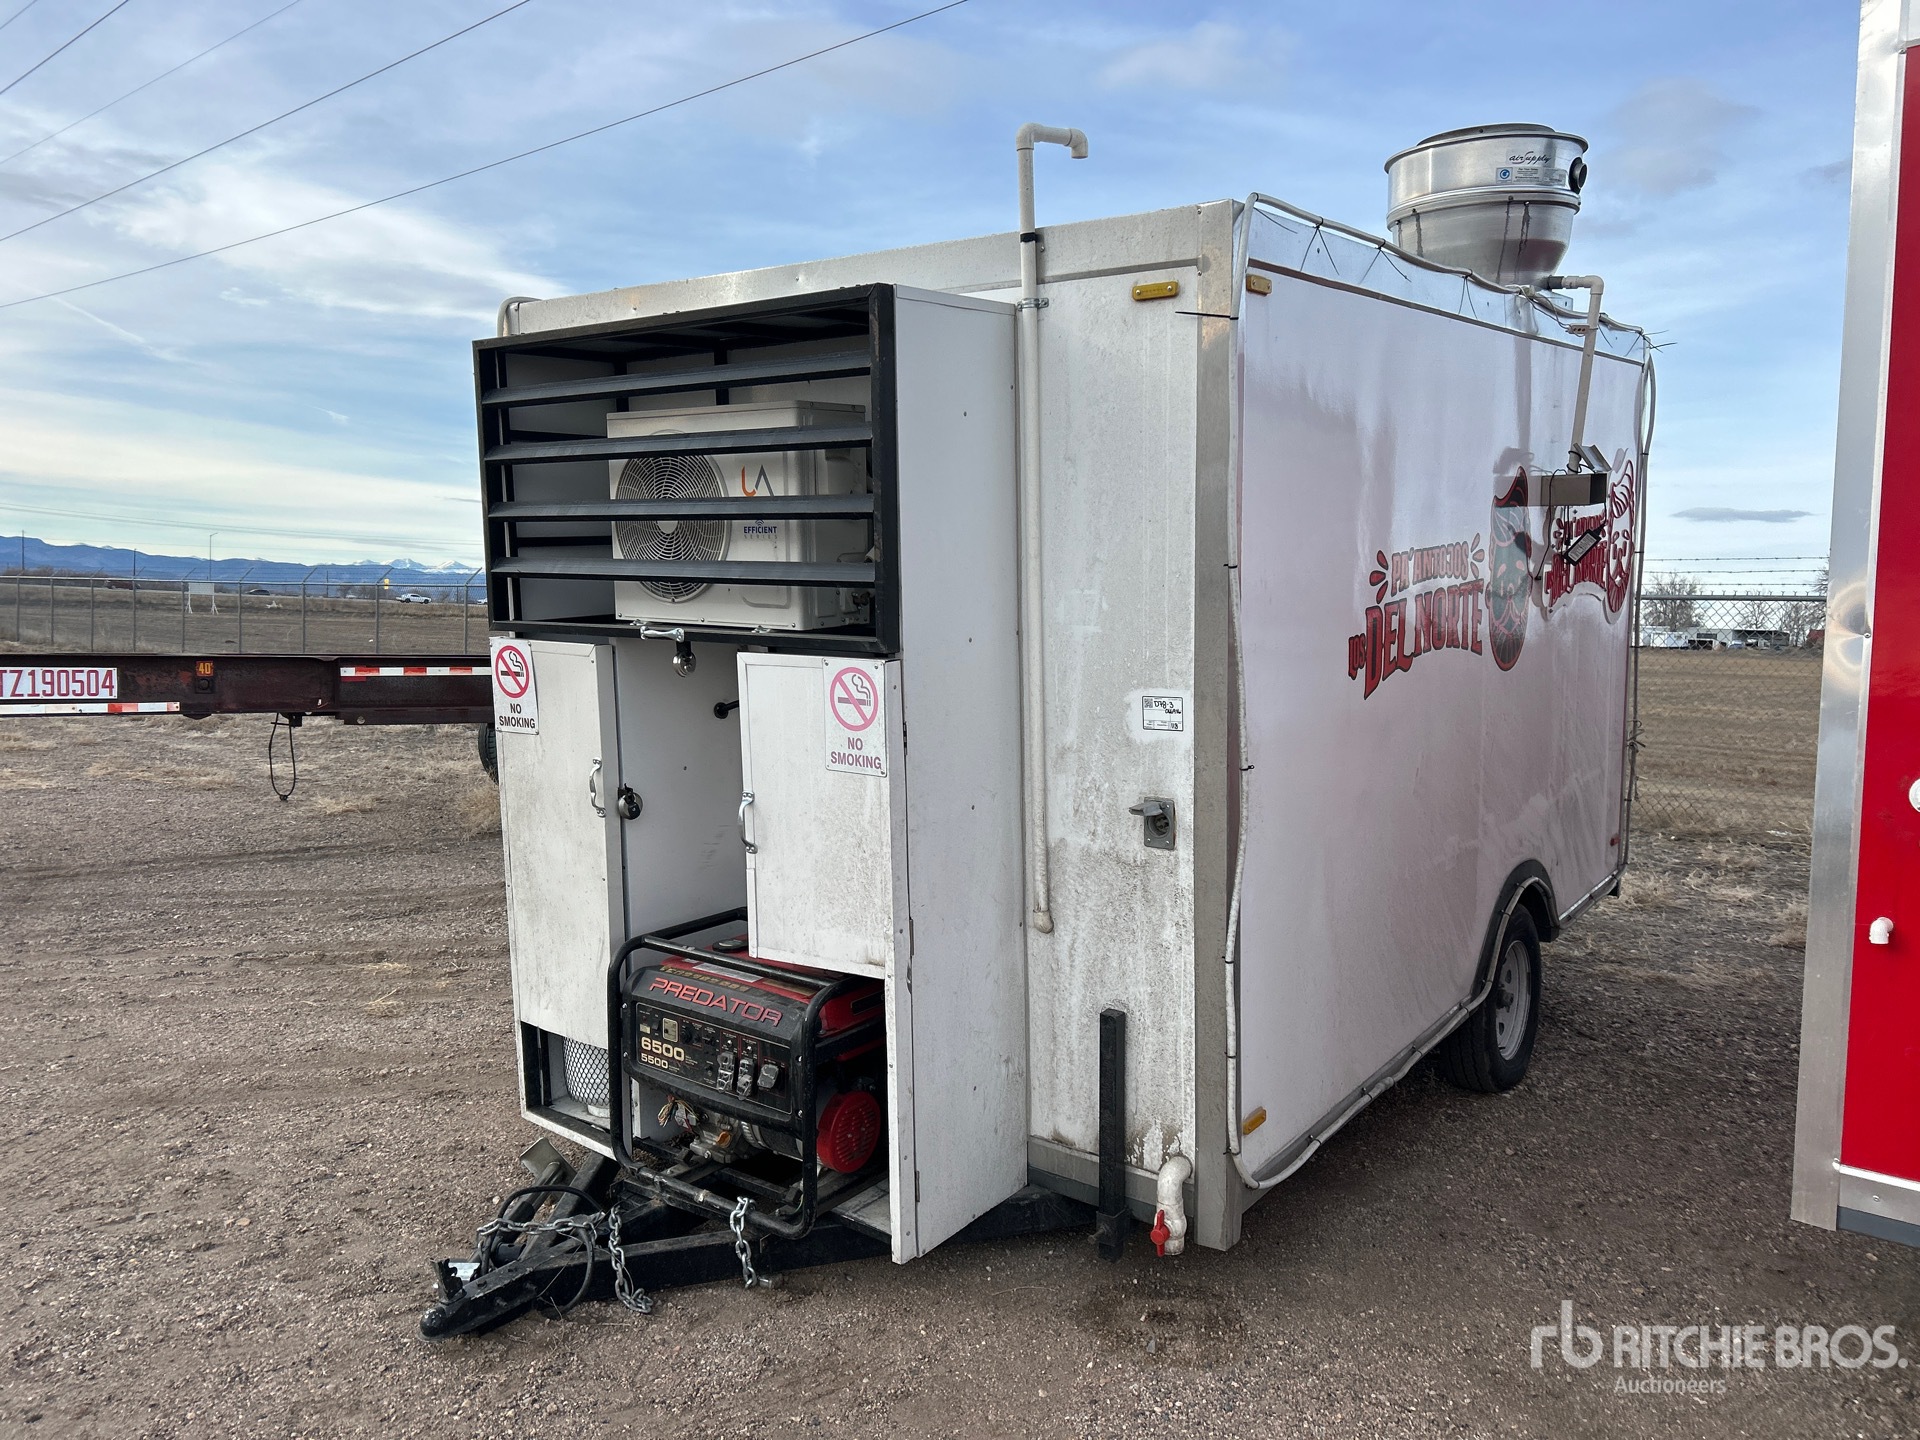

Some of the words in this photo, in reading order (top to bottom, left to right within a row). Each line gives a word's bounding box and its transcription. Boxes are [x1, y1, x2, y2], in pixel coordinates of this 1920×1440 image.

[743, 526, 778, 534] EFFICIENT
[1412, 541, 1469, 585] ANTOJOS
[1364, 598, 1414, 700] DEL
[1413, 578, 1485, 656] NORTE
[510, 703, 522, 714] NO
[499, 715, 536, 729] SMOKING
[847, 737, 864, 751] NO
[830, 751, 882, 770] SMOKING
[649, 977, 784, 1027] PREDATOR
[641, 1036, 685, 1062] 6500
[641, 1052, 669, 1069] 5500
